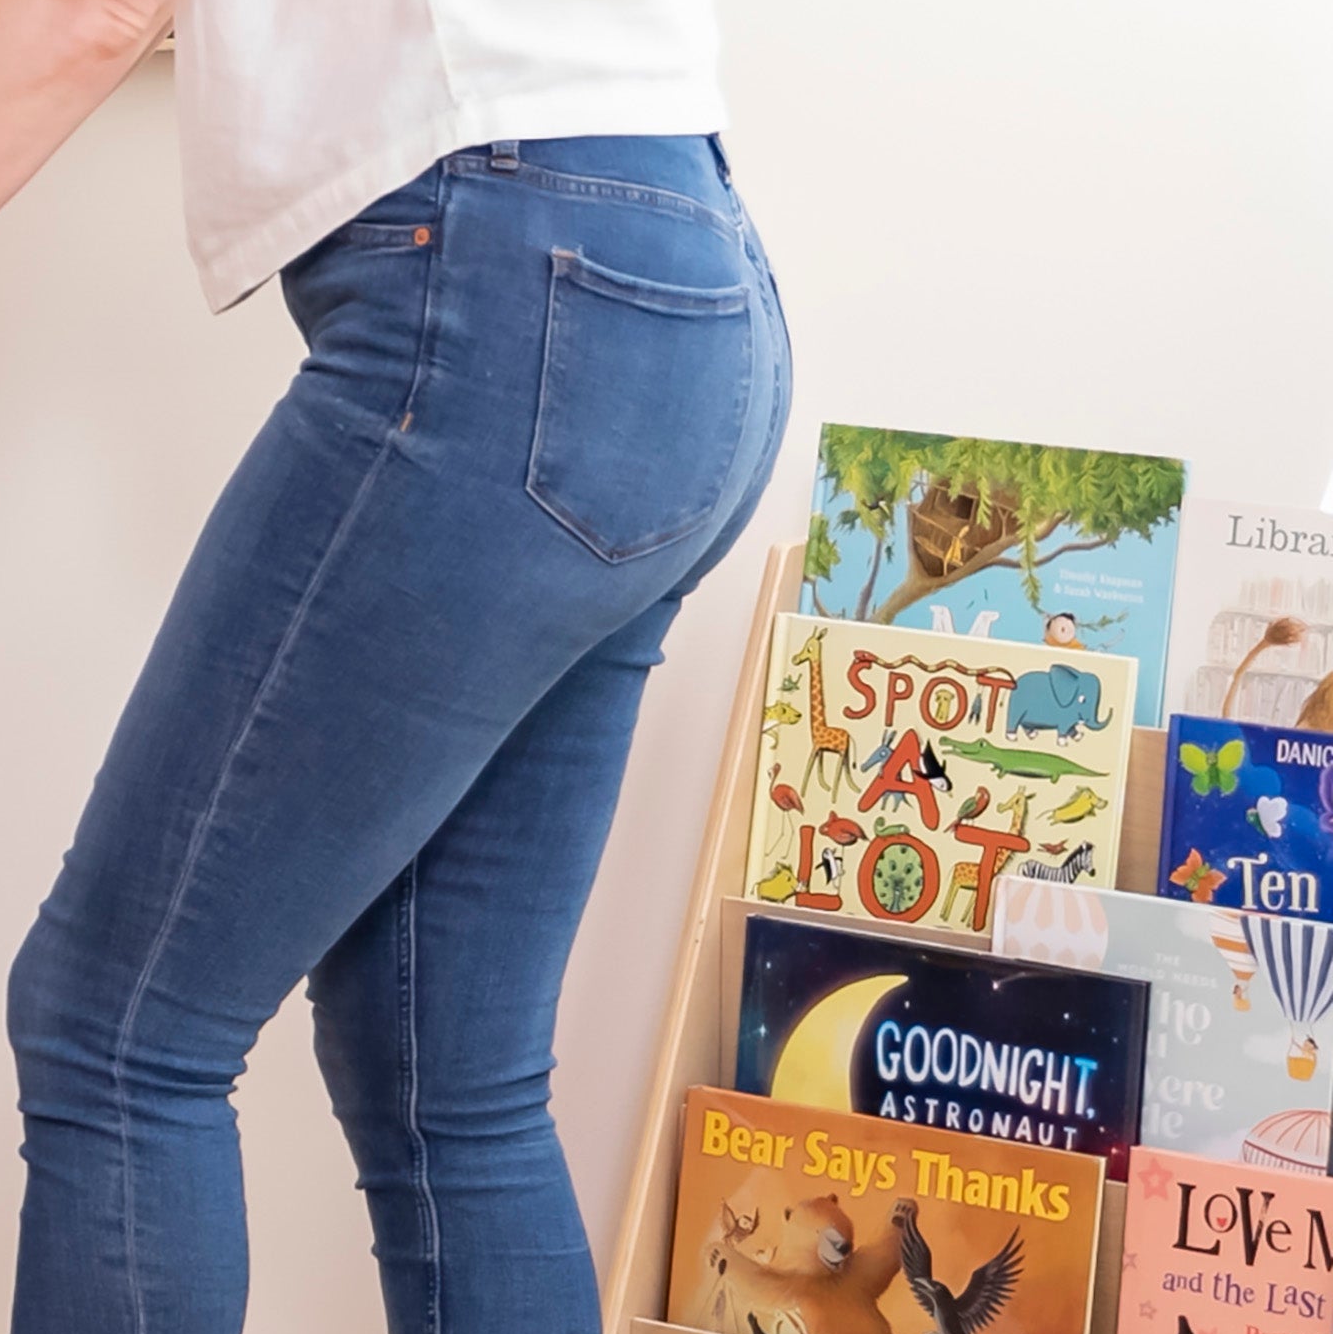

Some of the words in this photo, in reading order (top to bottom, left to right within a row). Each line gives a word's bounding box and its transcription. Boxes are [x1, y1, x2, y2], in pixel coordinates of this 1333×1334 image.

[1226, 514, 1333, 556] Libra
[843, 658, 1018, 733] SPOT
[858, 729, 940, 831] A
[796, 825, 1030, 931] LOT
[1227, 853, 1319, 913] Ten
[876, 1020, 1098, 1119] GOODNIGHT,
[880, 1091, 1078, 1150] ASTRONAUT
[702, 1109, 794, 1169] Bear
[803, 1131, 897, 1197] Says
[911, 1149, 1071, 1222] Thanks
[1162, 1272, 1204, 1294] and
[1212, 1273, 1255, 1307] the
